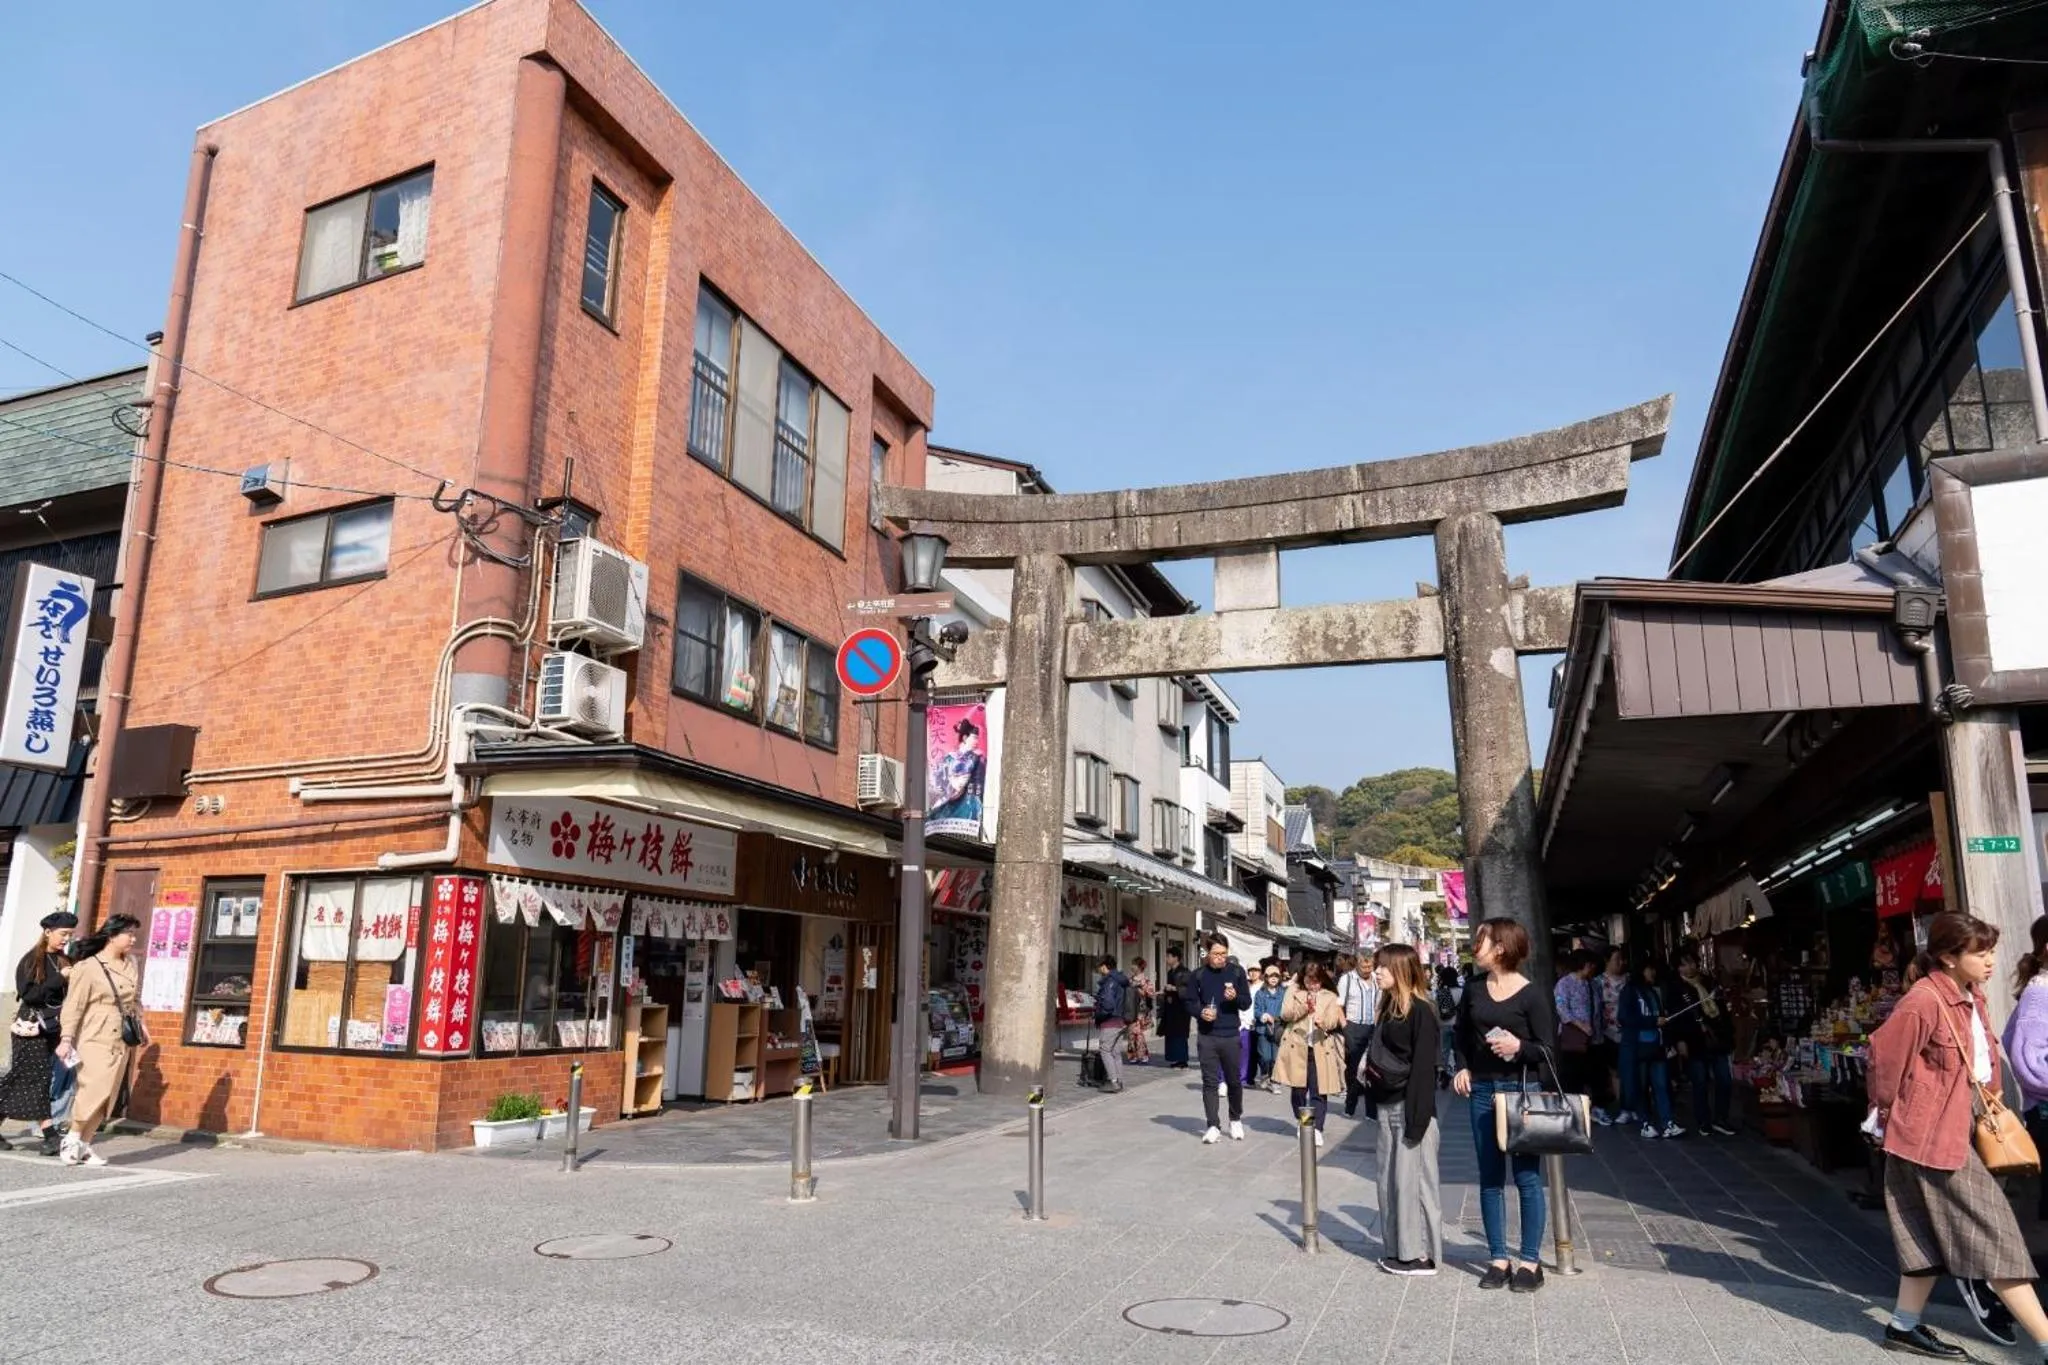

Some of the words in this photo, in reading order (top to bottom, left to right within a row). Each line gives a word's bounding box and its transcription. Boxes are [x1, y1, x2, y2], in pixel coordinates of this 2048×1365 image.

[25, 645, 65, 754] せいろ蒸し
[508, 829, 535, 848] 名物
[586, 811, 694, 883] 梅ヶ枝餅
[314, 905, 346, 924] 名物
[355, 913, 403, 940] ヶ枝餅
[426, 919, 450, 1024] 梅ヶ枝餅
[451, 920, 475, 1026] 梅ヶ枝餅
